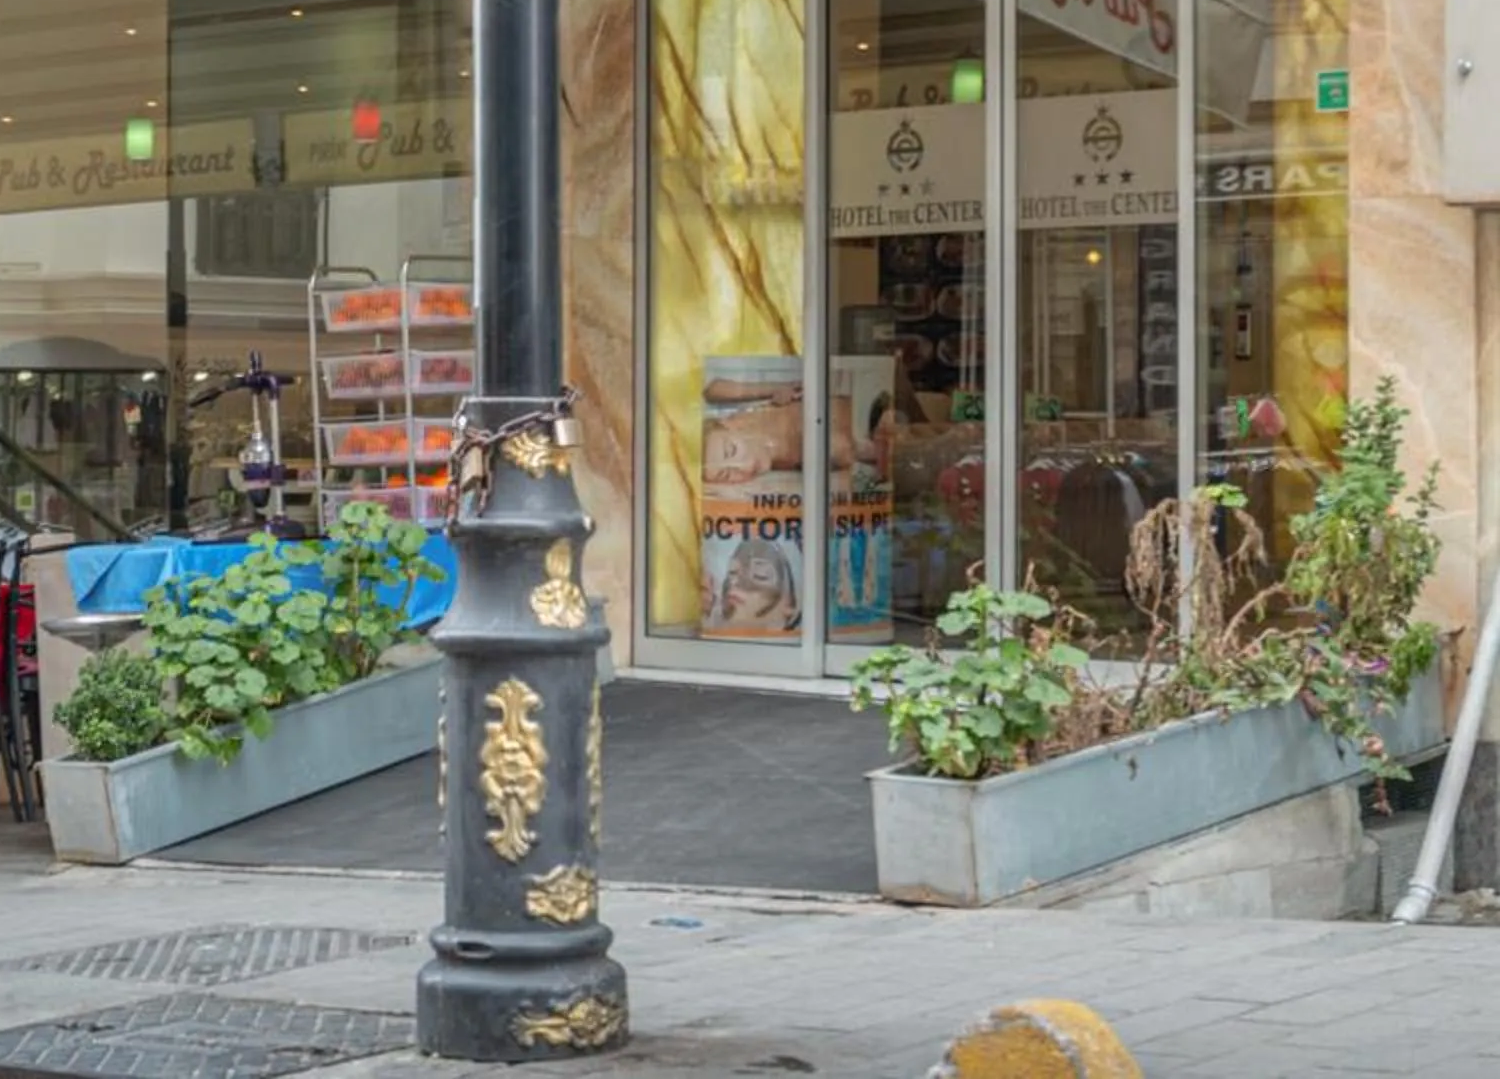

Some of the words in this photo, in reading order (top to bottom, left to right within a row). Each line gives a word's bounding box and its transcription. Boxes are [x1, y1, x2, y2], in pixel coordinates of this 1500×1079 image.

[831, 205, 884, 228] HOTEL
[913, 199, 985, 225] CENTER
[1020, 194, 1082, 221] HOTEL
[1110, 190, 1180, 217] CENTE
